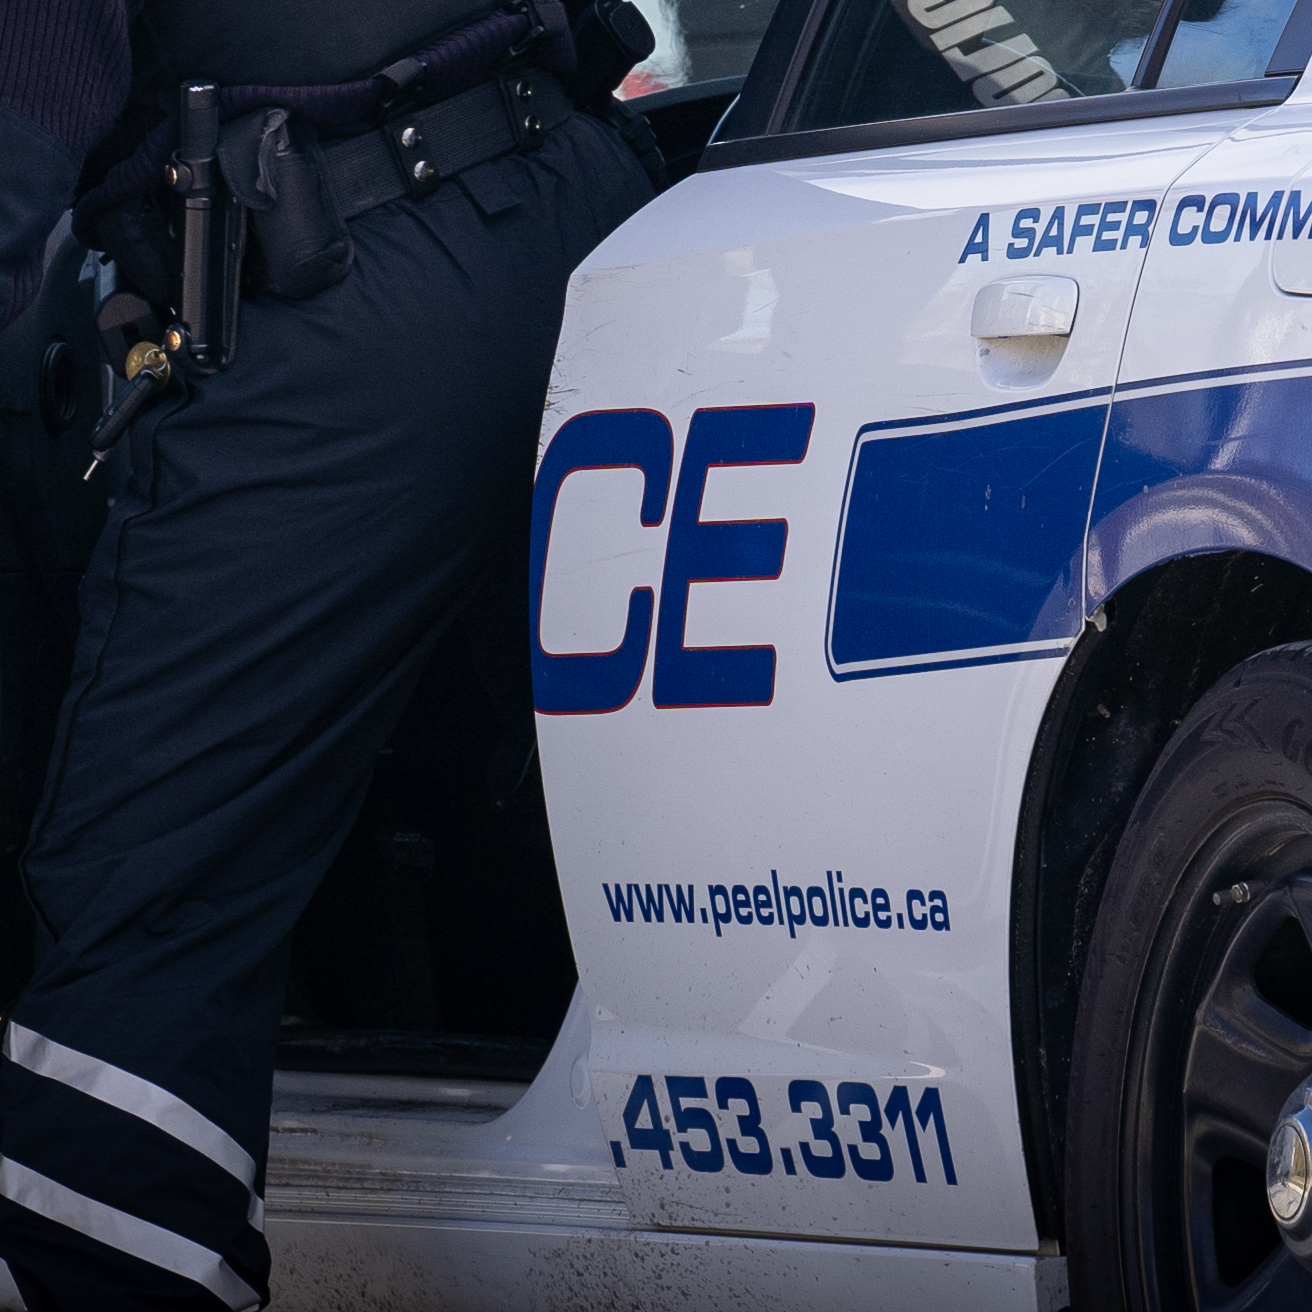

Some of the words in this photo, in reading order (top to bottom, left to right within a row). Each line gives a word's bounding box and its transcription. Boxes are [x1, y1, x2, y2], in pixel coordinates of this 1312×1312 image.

[958, 213, 990, 264] A
[1006, 199, 1157, 260] SAFER
[529, 403, 816, 715] CE
[602, 869, 951, 939] www.peelpolice.ca
